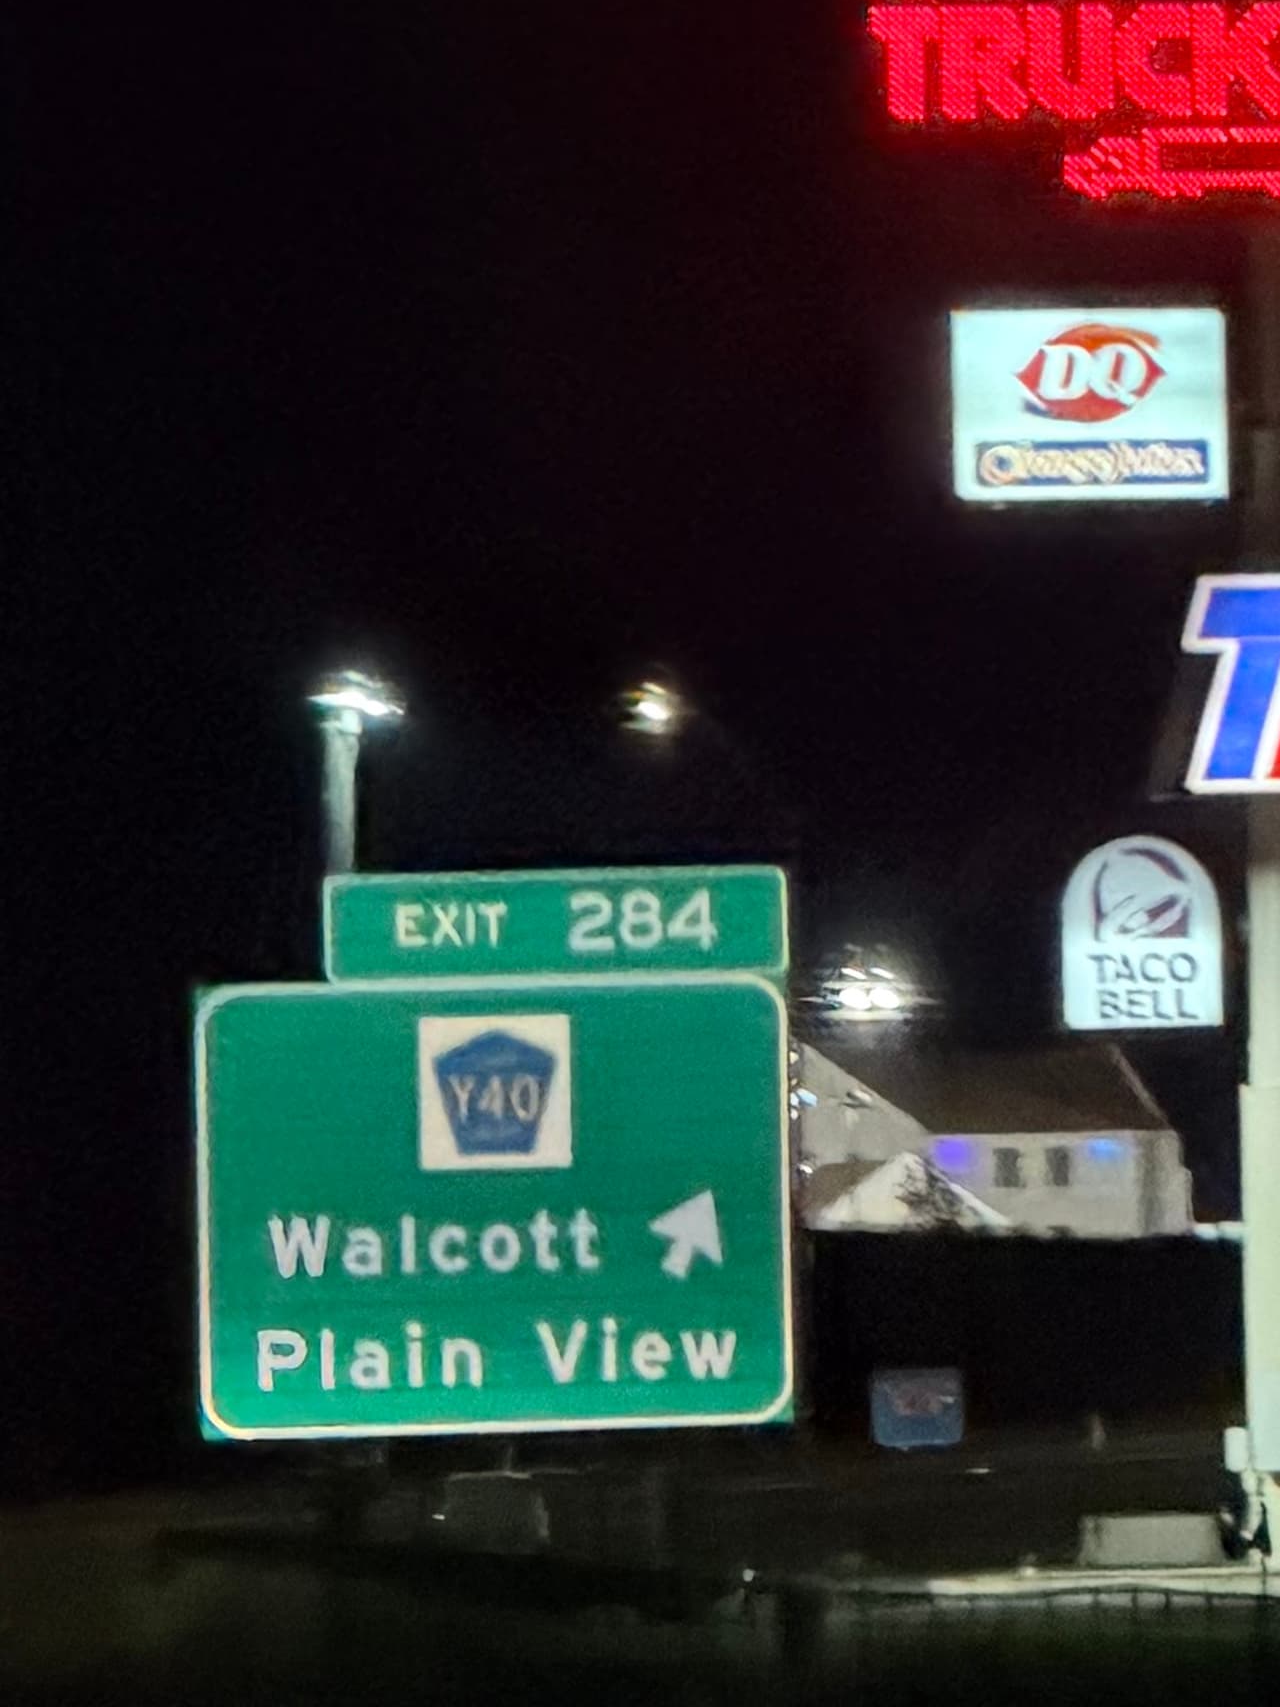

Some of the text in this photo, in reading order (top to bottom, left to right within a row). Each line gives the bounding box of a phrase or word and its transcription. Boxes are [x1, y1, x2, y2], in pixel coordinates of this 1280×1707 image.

[1038, 342, 1149, 406] DQ
[394, 889, 719, 953] EXIT 284
[1087, 952, 1198, 983] TACO
[1097, 988, 1199, 1020] BELL
[447, 1073, 541, 1124] Y40
[267, 1207, 602, 1280] Walcott
[255, 1316, 737, 1392] Plain View
